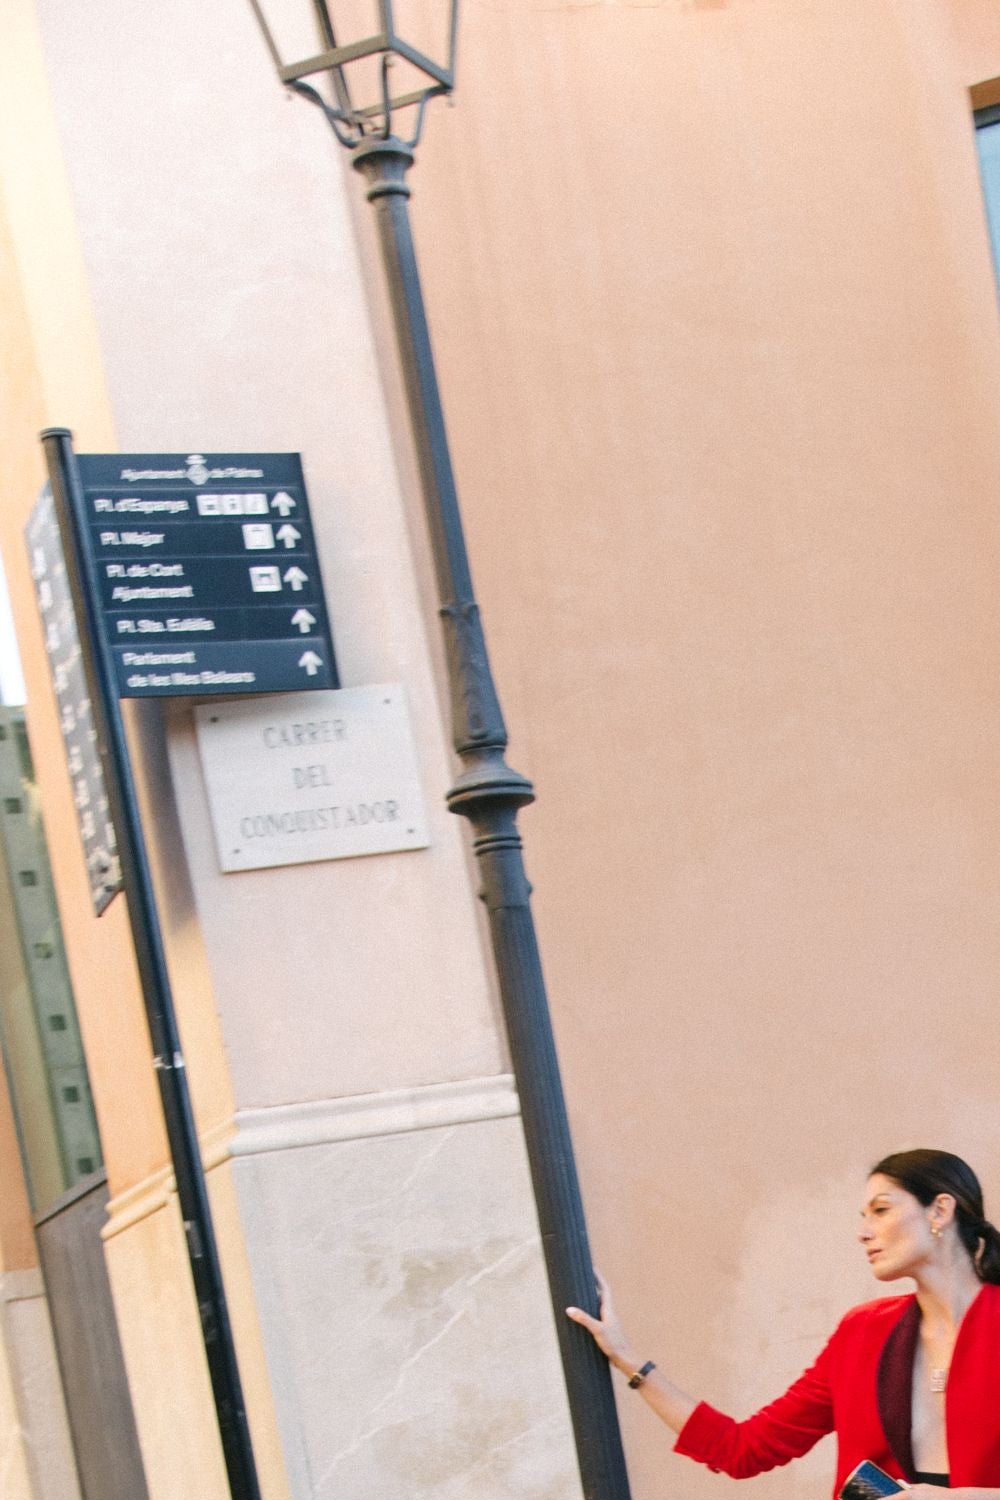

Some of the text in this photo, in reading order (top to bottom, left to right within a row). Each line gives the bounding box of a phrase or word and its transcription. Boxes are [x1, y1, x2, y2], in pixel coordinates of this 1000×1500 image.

[112, 585, 195, 602] Ajuntament
[263, 719, 346, 749] CARRER
[291, 764, 333, 789] DEL
[240, 800, 399, 839] CONQUISTADOR
